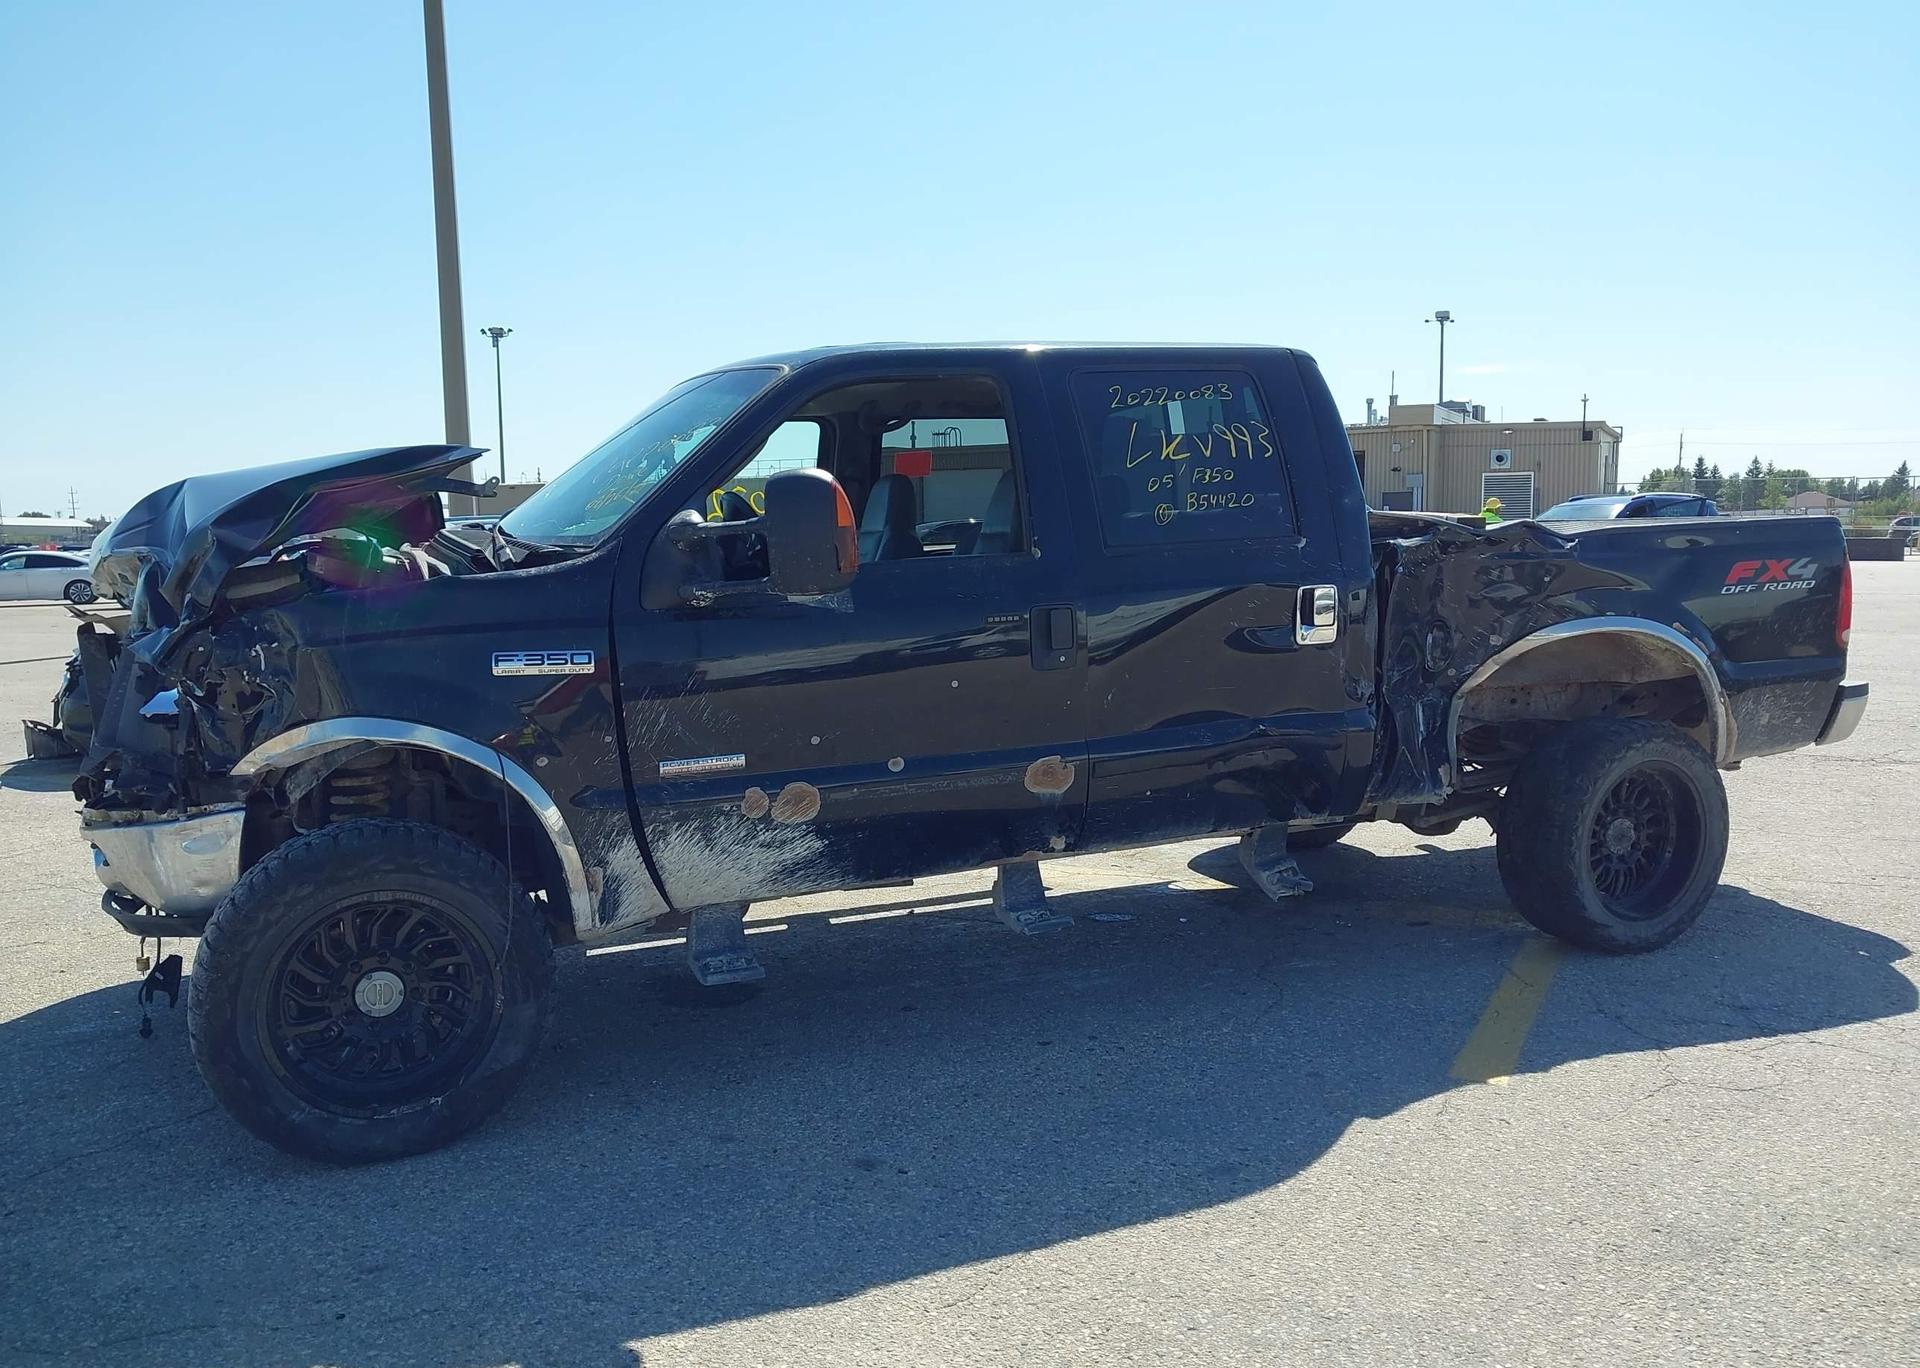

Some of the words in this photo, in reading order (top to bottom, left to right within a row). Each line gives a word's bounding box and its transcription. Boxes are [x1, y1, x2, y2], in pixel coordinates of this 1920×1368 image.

[1109, 383, 1233, 408] 20220083
[1192, 467, 1234, 484] F350
[1186, 492, 1255, 512] B54420
[1724, 557, 1819, 585] FX4
[1721, 584, 1758, 595] OFF
[1763, 580, 1816, 592] ROAD
[494, 653, 593, 667] F-350
